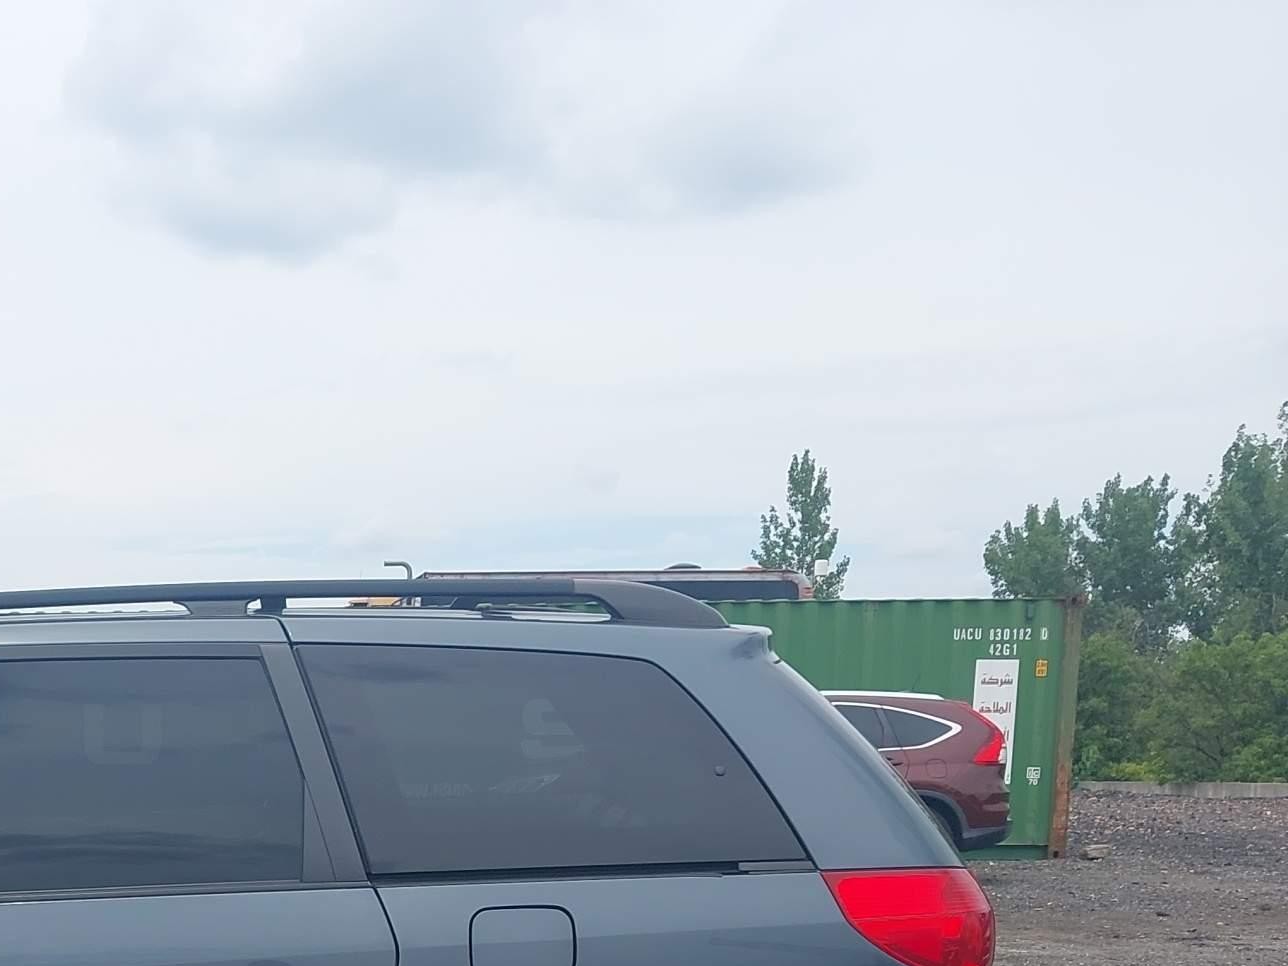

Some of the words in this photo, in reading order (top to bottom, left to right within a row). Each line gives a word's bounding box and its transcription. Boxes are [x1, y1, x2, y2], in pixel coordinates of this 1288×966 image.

[953, 627, 982, 641] UACU
[988, 643, 1017, 656] 42G1
[980, 672, 1014, 687] شركة
[978, 701, 1012, 715] الملاحة
